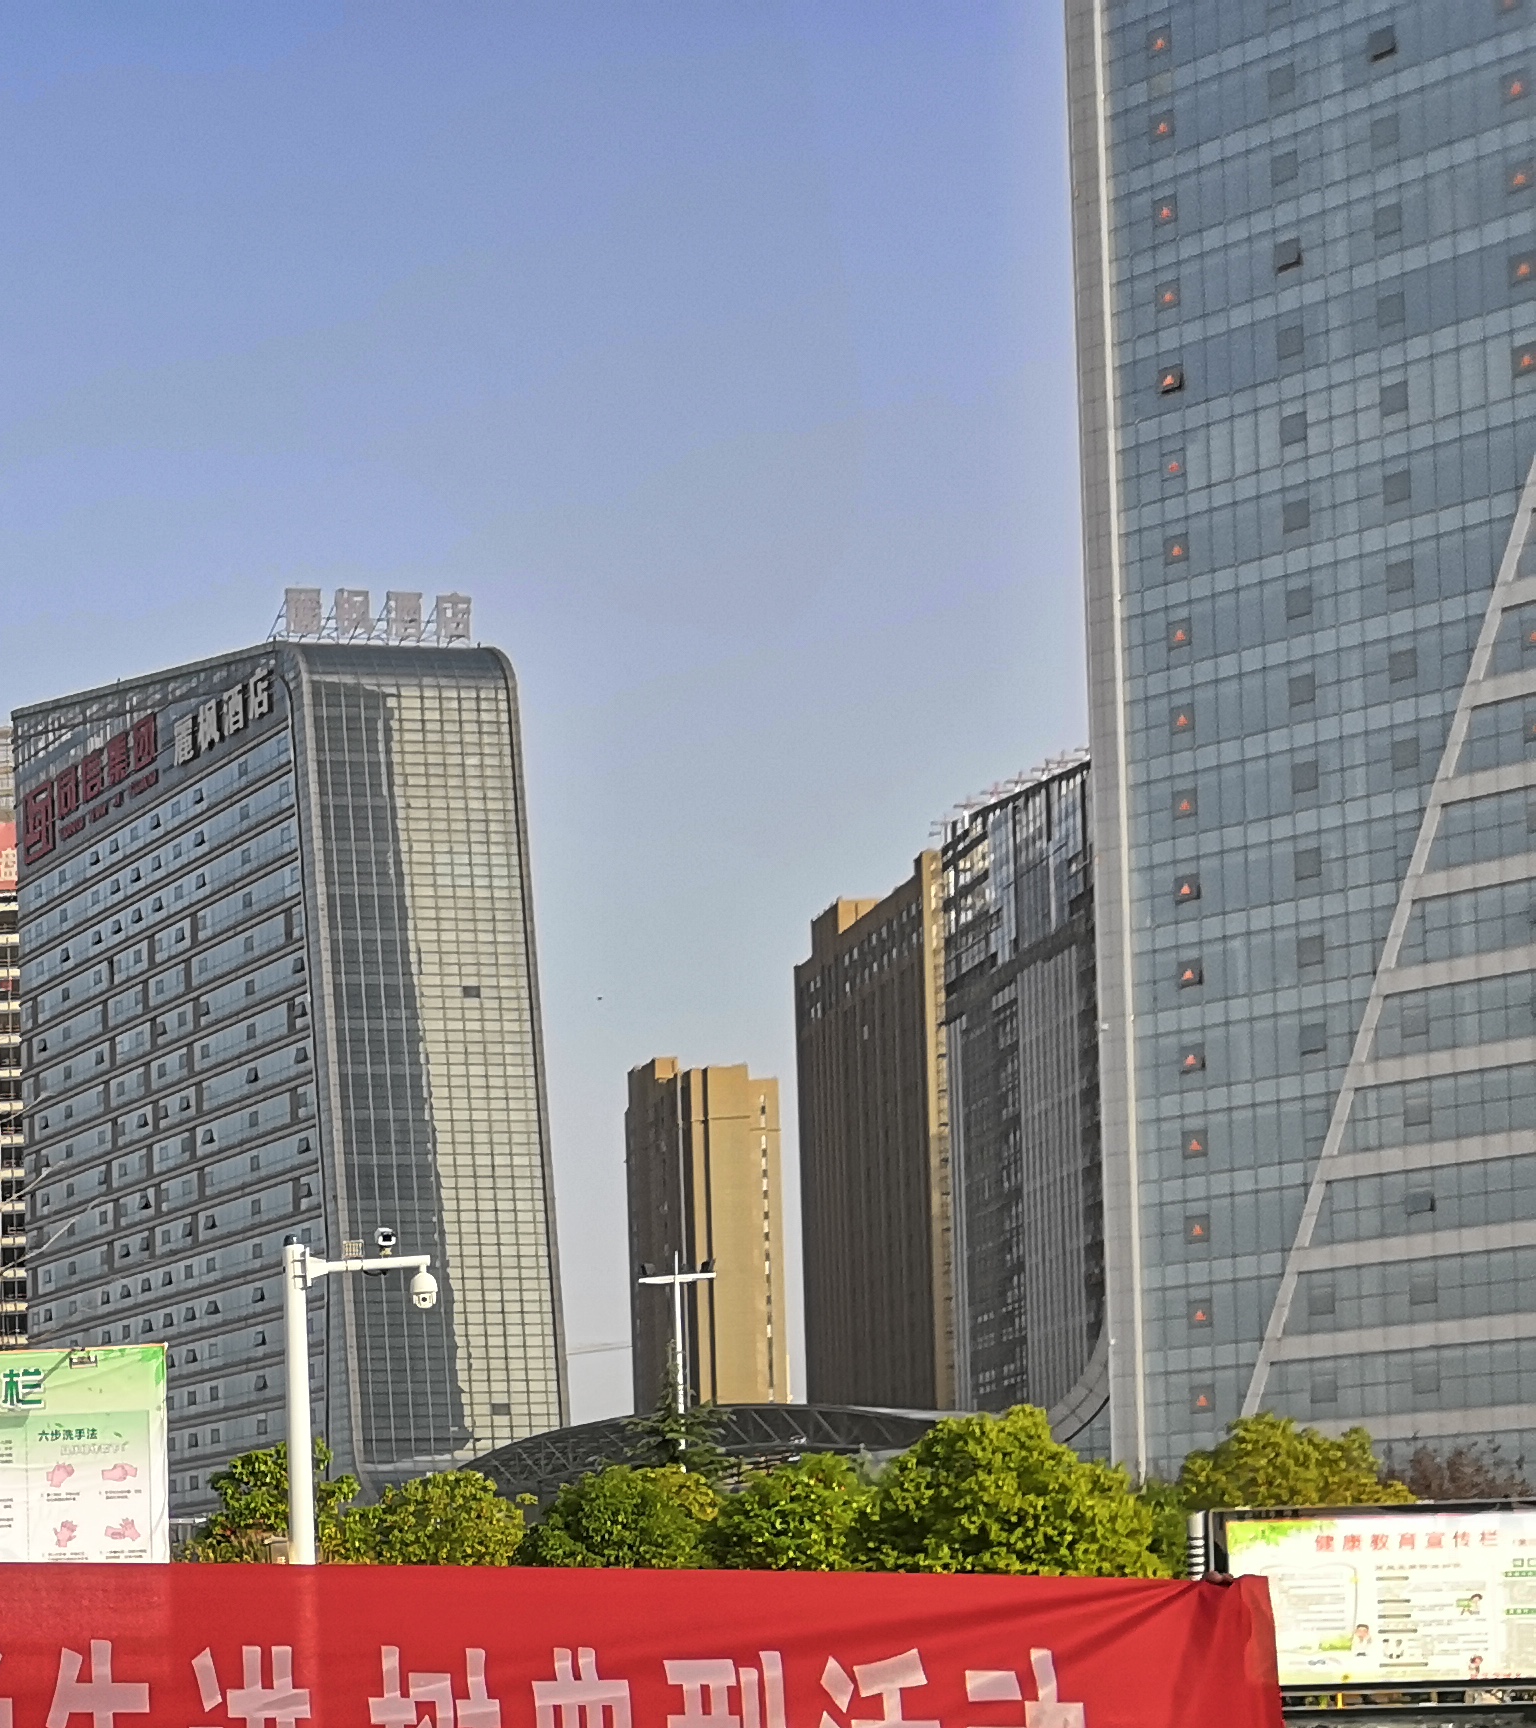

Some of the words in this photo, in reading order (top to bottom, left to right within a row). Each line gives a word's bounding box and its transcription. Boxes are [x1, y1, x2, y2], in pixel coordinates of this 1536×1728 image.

[1314, 1529, 1499, 1552] 健康教育宣传栏
